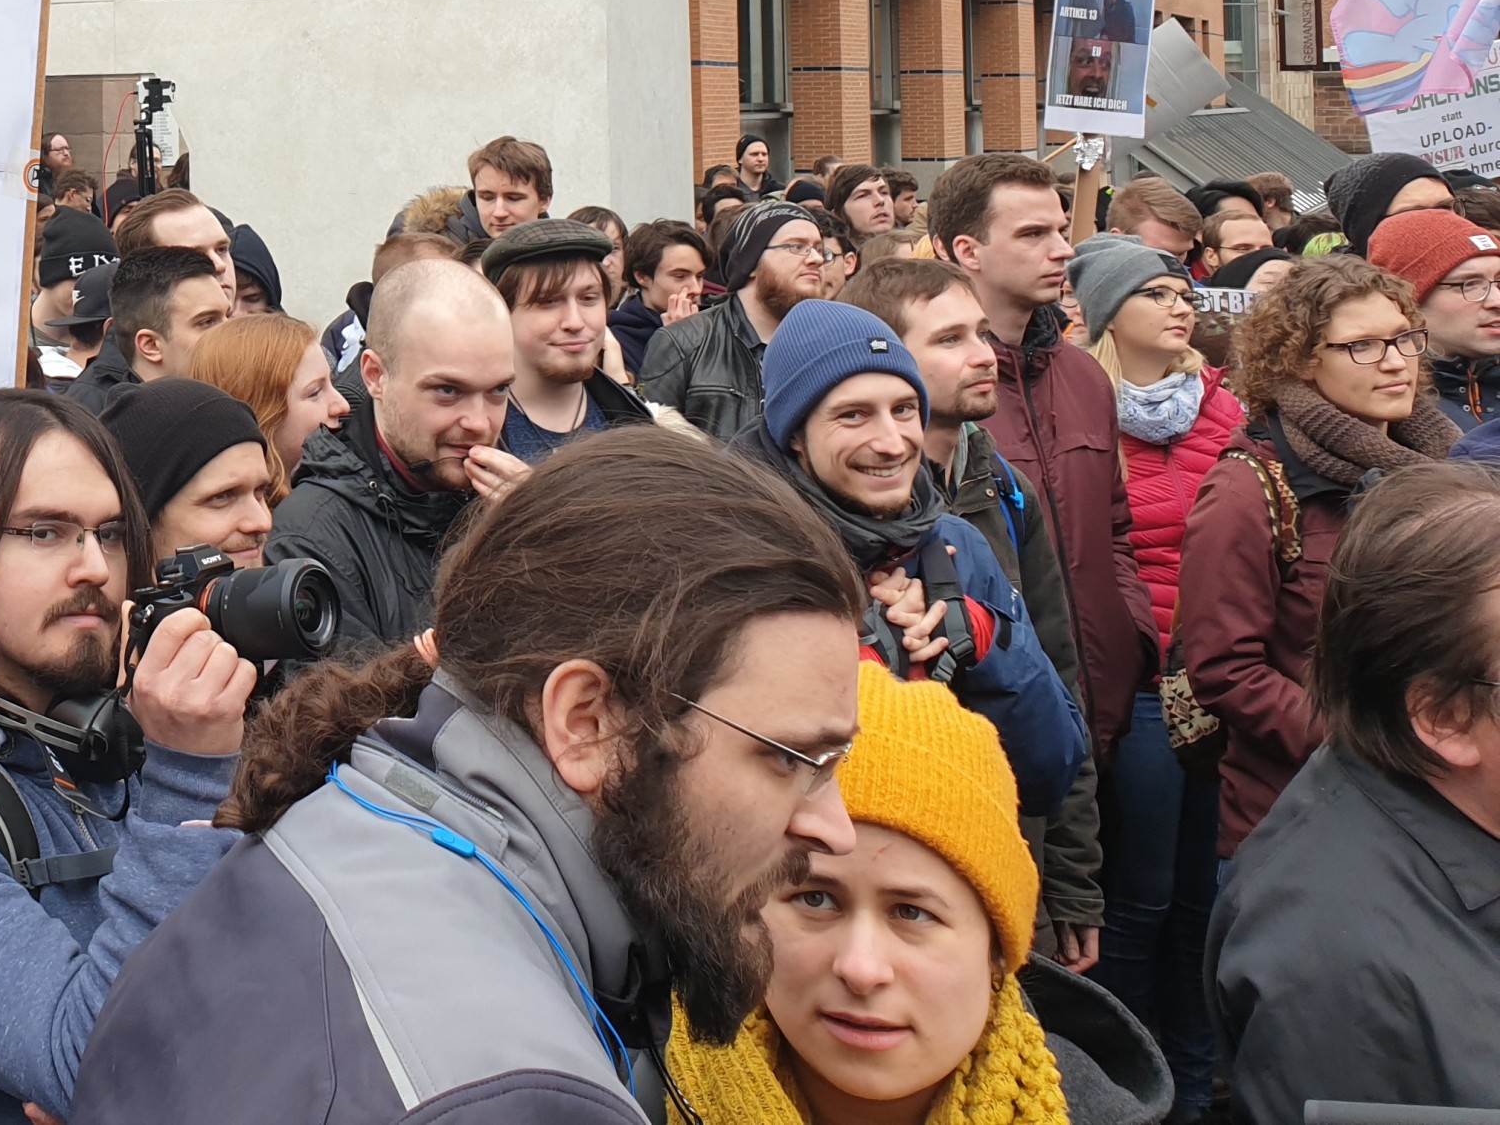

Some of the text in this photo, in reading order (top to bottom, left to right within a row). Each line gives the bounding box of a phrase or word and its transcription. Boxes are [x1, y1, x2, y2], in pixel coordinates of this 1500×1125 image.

[1060, 6, 1098, 21] ARTIKEL 13
[1092, 46, 1102, 57] EU
[1055, 94, 1127, 110] JETZT HABE ICH DICH
[1441, 111, 1463, 123] statt
[1420, 121, 1493, 148] UPLOAD-
[201, 554, 222, 565] SONY
